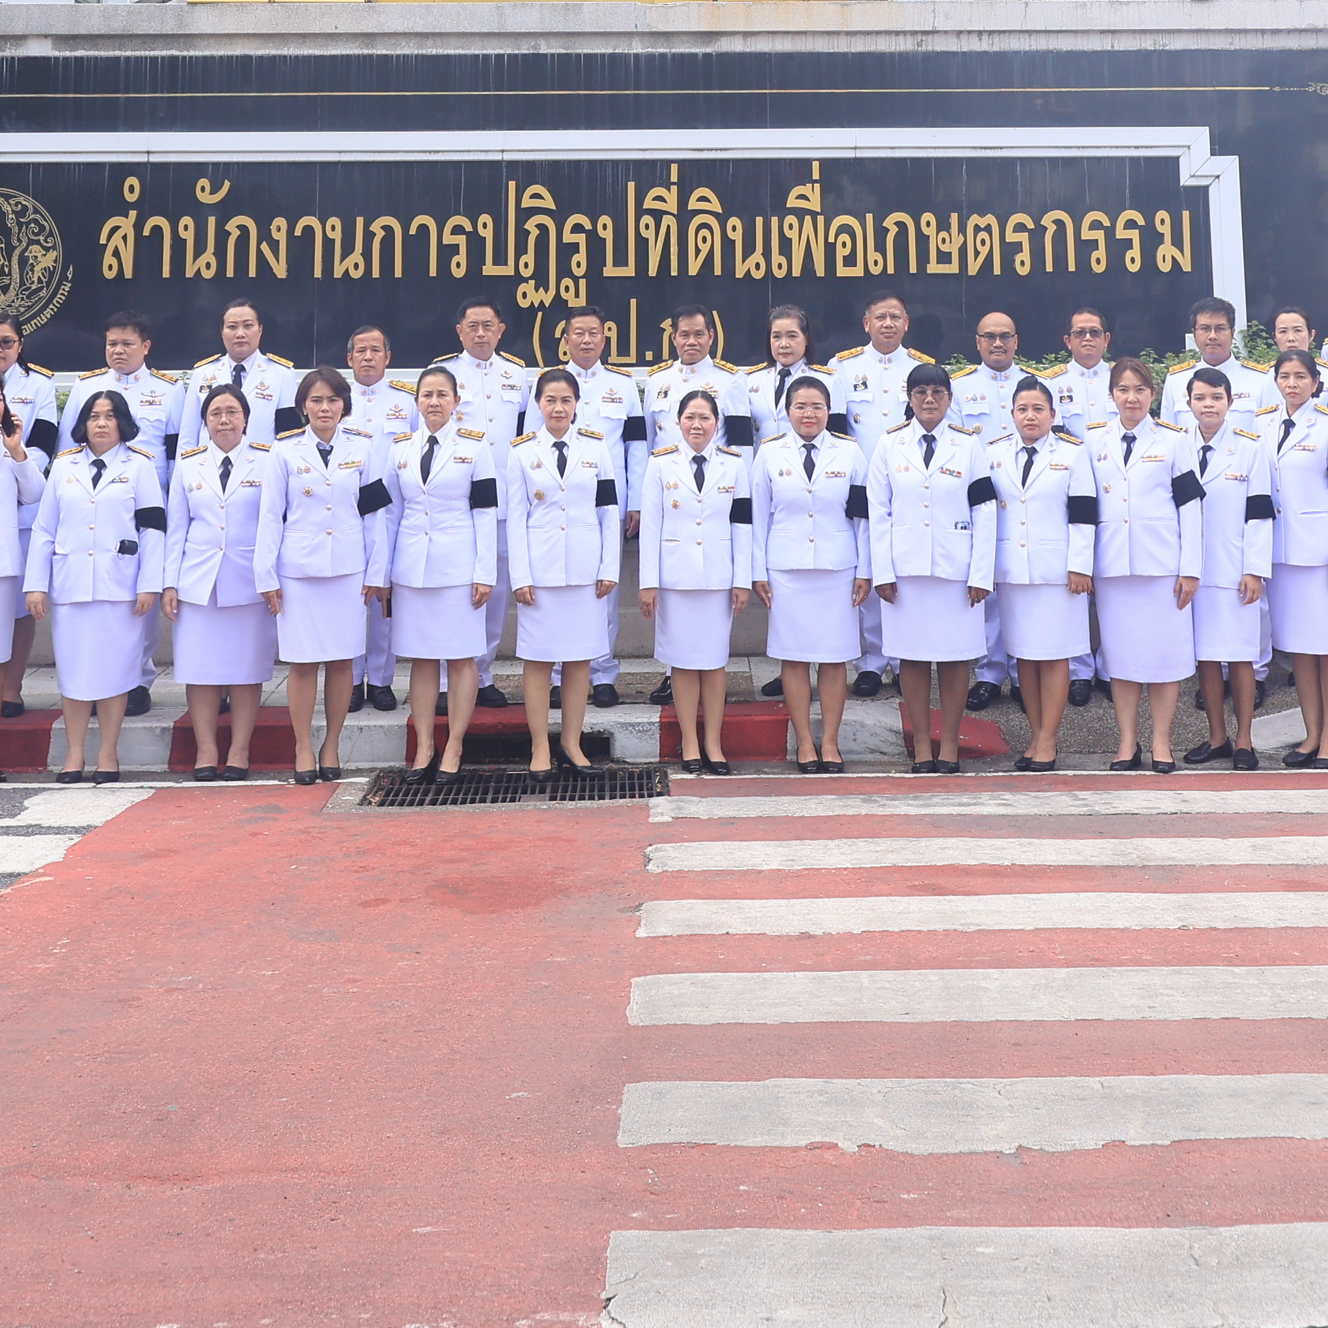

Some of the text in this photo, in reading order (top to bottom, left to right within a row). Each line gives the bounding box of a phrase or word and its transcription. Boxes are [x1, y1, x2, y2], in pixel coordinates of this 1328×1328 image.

[99, 160, 1192, 308] สำนักงานการปฏิรูปที่ดินเพื่อเกษตรกรรม
